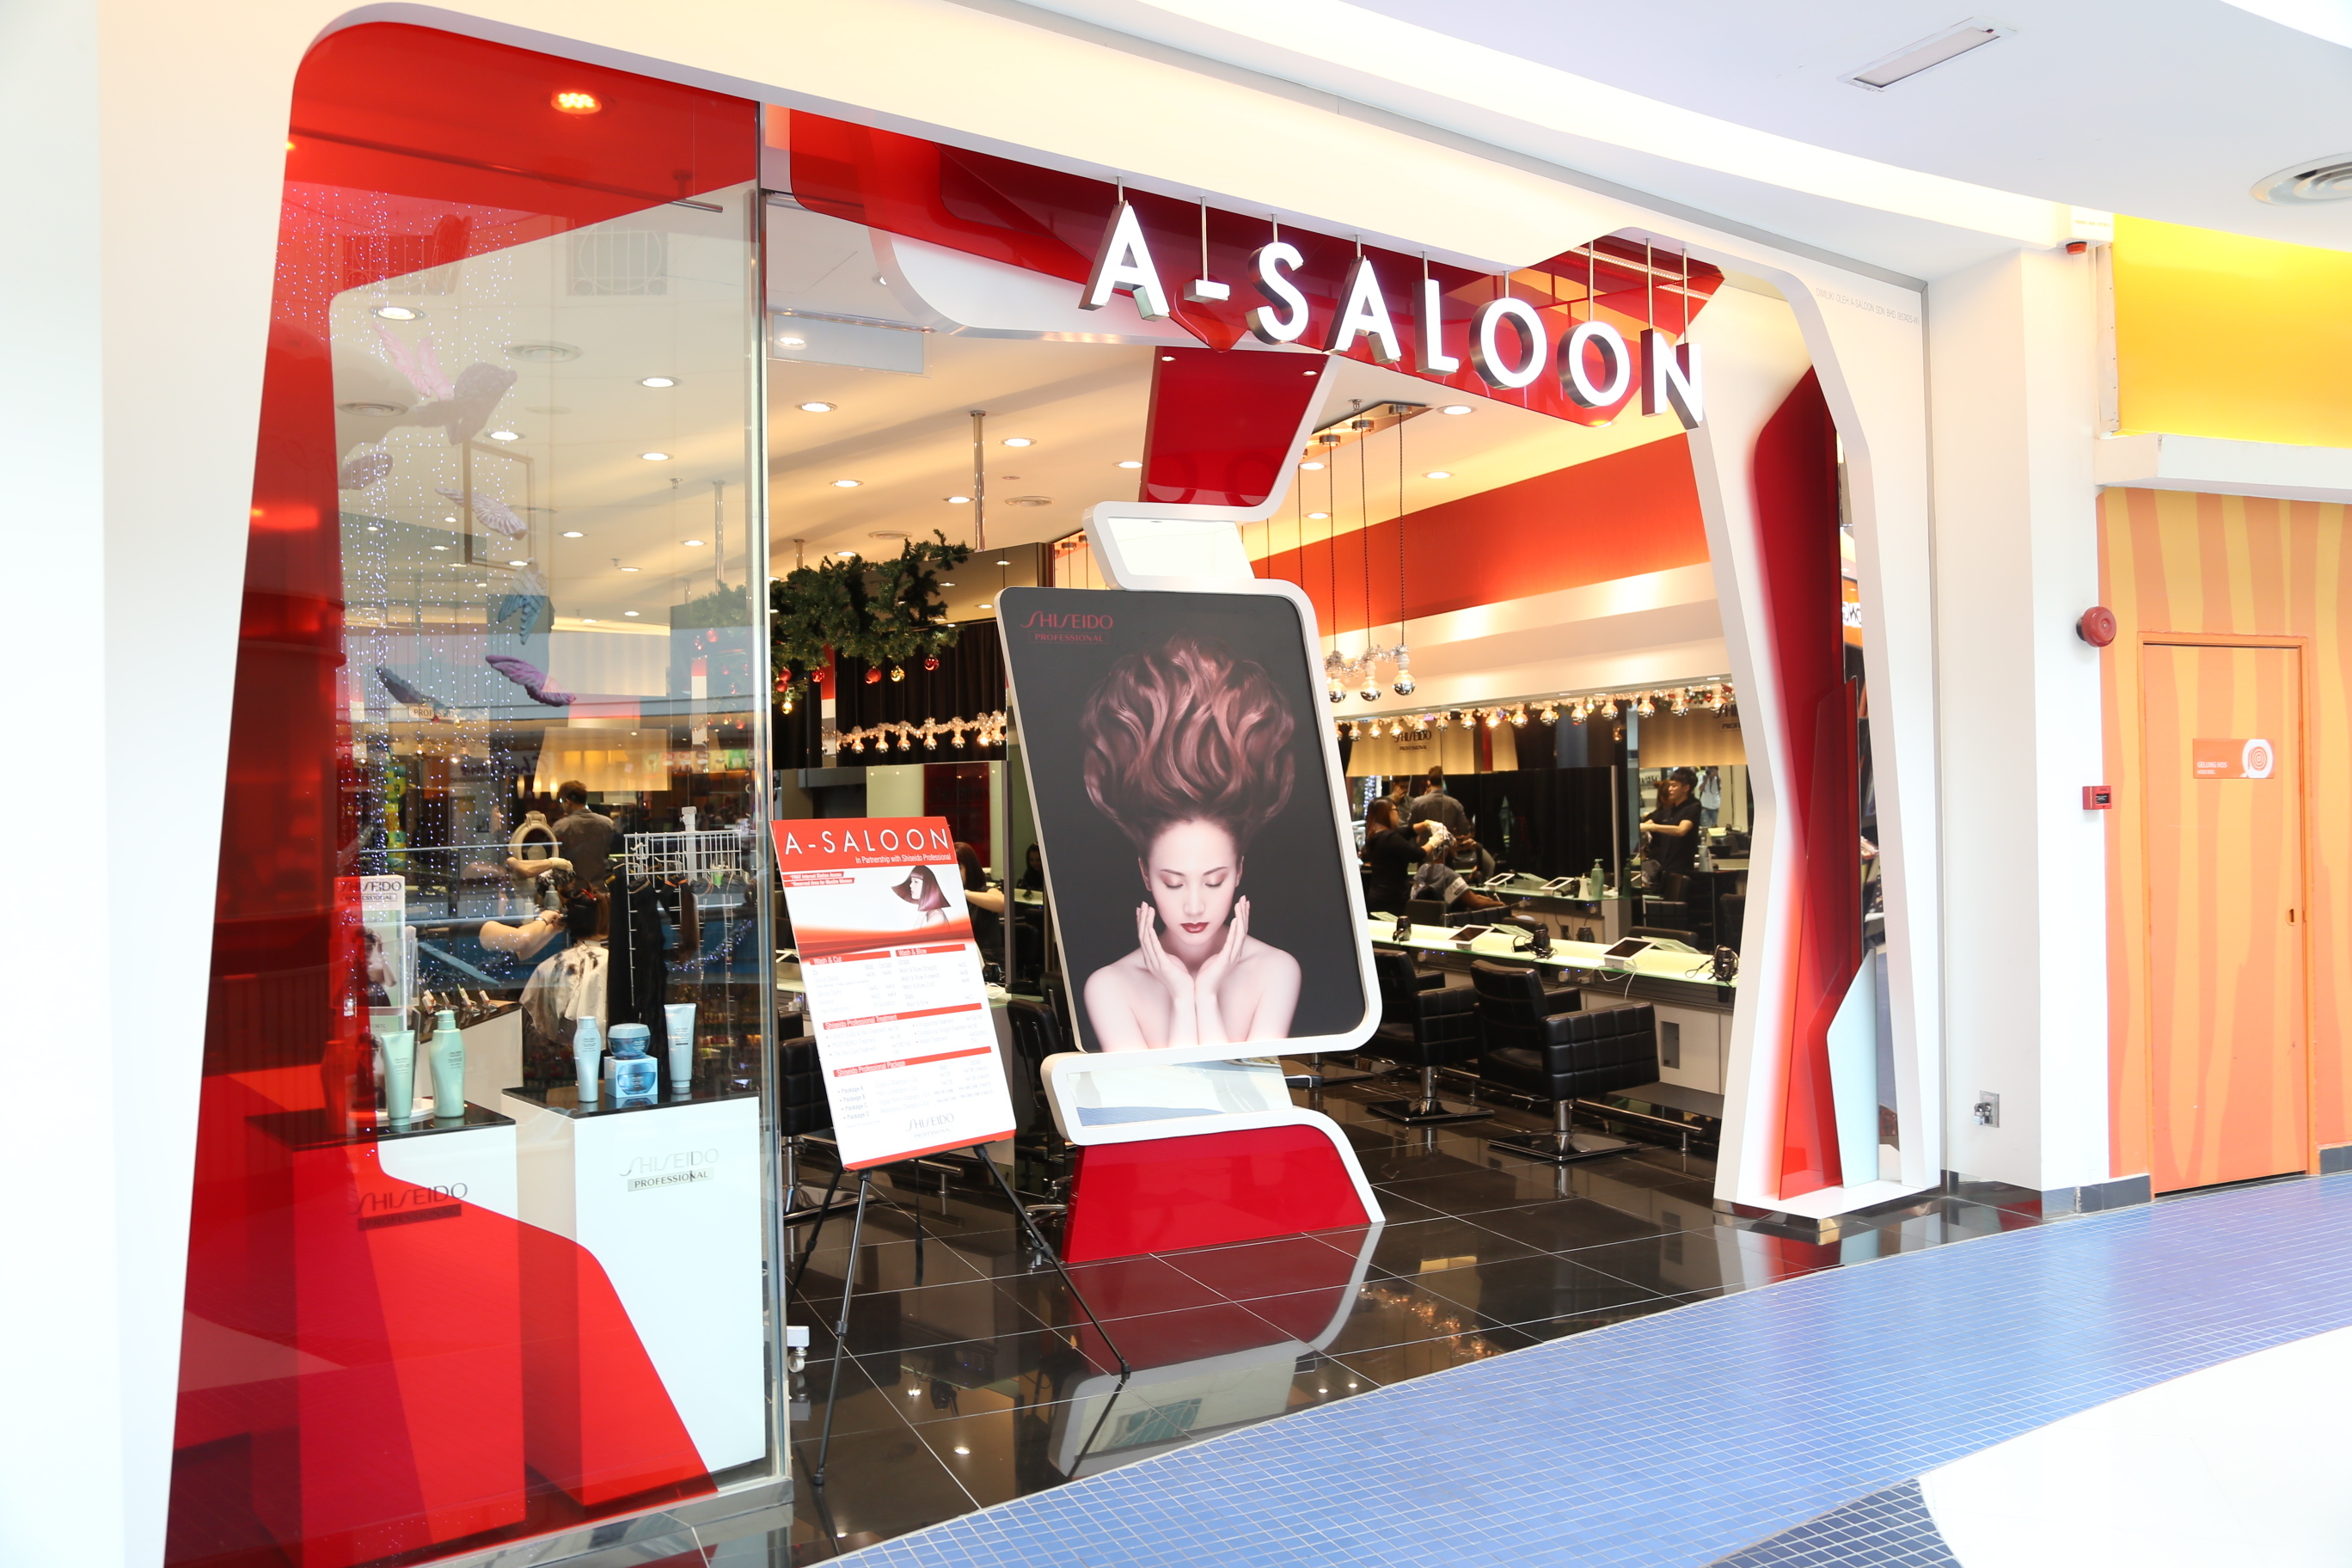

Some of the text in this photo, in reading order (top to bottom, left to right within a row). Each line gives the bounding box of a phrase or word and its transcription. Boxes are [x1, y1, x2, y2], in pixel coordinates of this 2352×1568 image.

[1077, 199, 1704, 428] A-SALOON
[1851, 298, 1874, 312] A-SALOON
[1875, 305, 1885, 315] SDN
[1886, 309, 1896, 319] BHD
[1020, 610, 1114, 629] SHISEIDO
[1034, 633, 1104, 642] PROFESSIONAL
[784, 828, 949, 855] A-SALOON
[861, 854, 891, 864] Partnership
[902, 854, 923, 862] Shiseido
[922, 853, 952, 861] Professional
[825, 1014, 898, 1030] Shiseido Professional Treatment
[836, 1061, 906, 1077] Shiseido Professional Package
[906, 1112, 955, 1132] SHISEIDO
[914, 1127, 952, 1139] PROFESSIONAL
[619, 1148, 720, 1177] SHISEIDO
[634, 1170, 708, 1188] PROFESSIONAL
[347, 1182, 469, 1215] SHISEIDO
[365, 1207, 456, 1227] PROFESSIONAL
